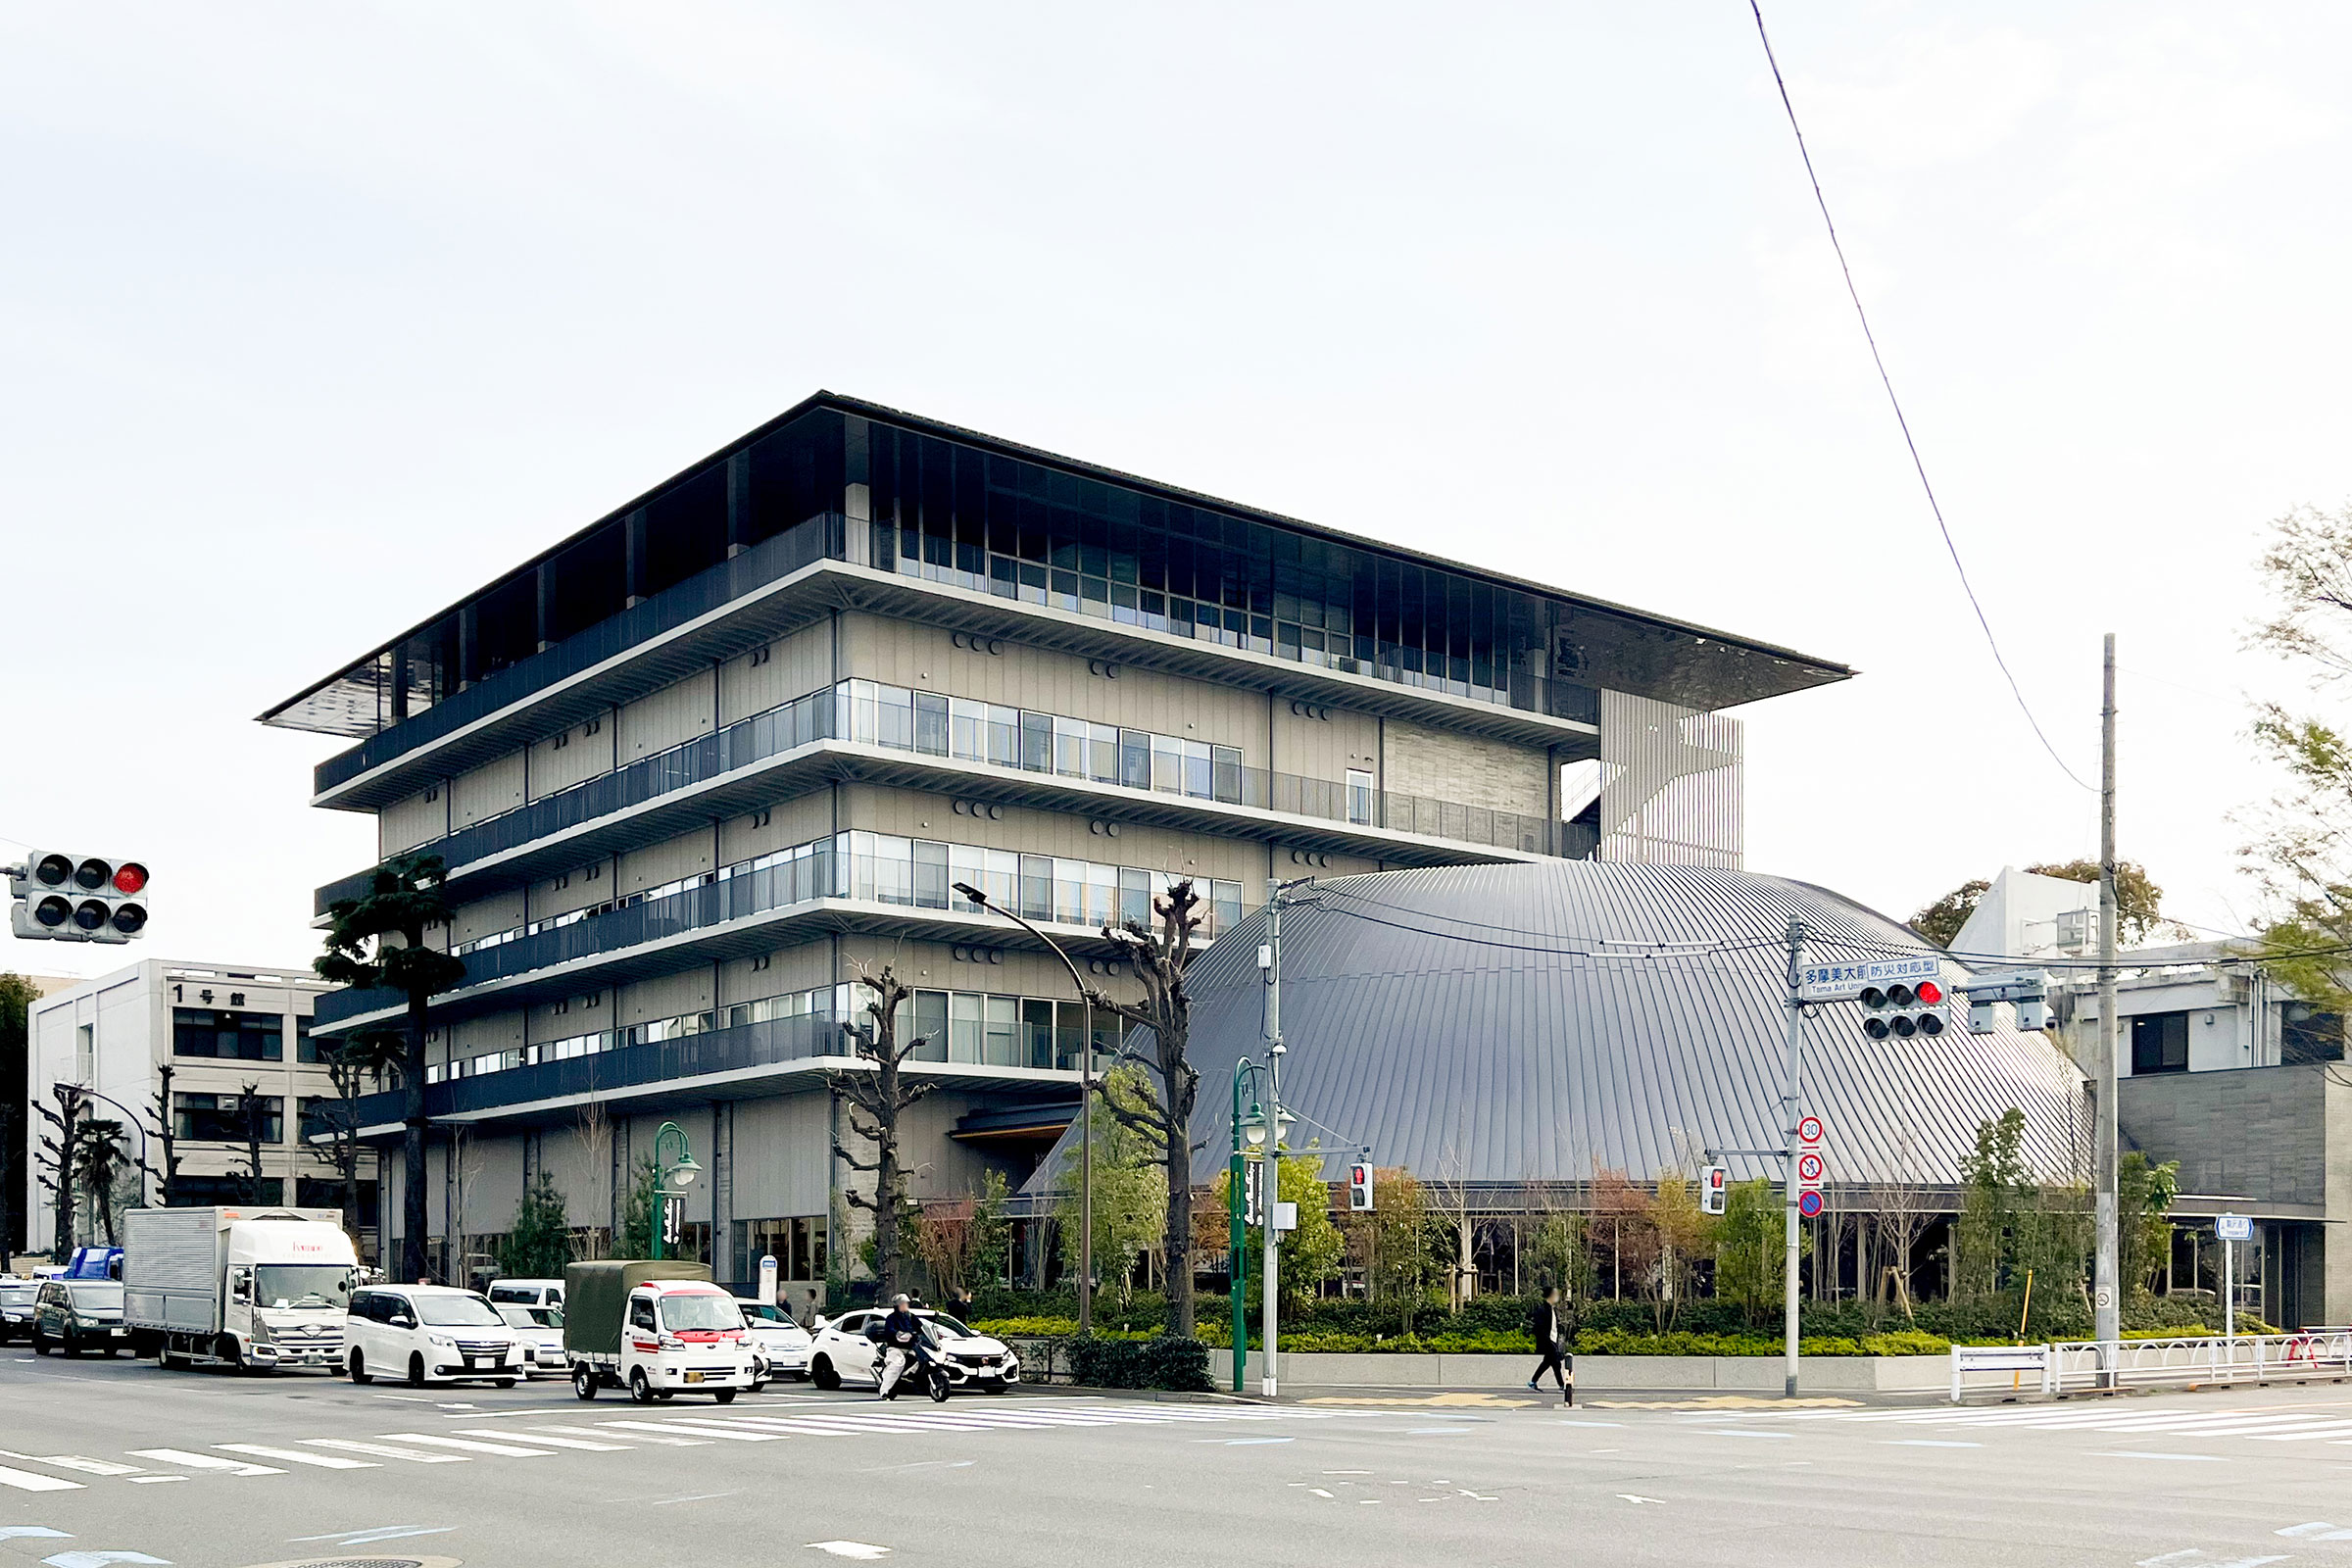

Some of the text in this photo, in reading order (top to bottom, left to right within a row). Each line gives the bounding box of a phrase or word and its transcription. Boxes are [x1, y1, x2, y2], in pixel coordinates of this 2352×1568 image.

[1805, 964, 1866, 985] 多摩美大前
[1871, 959, 1935, 977] 防災対応型
[1812, 984, 1832, 993] Tama
[1835, 982, 1845, 991] Art
[1804, 1124, 1818, 1135] 30
